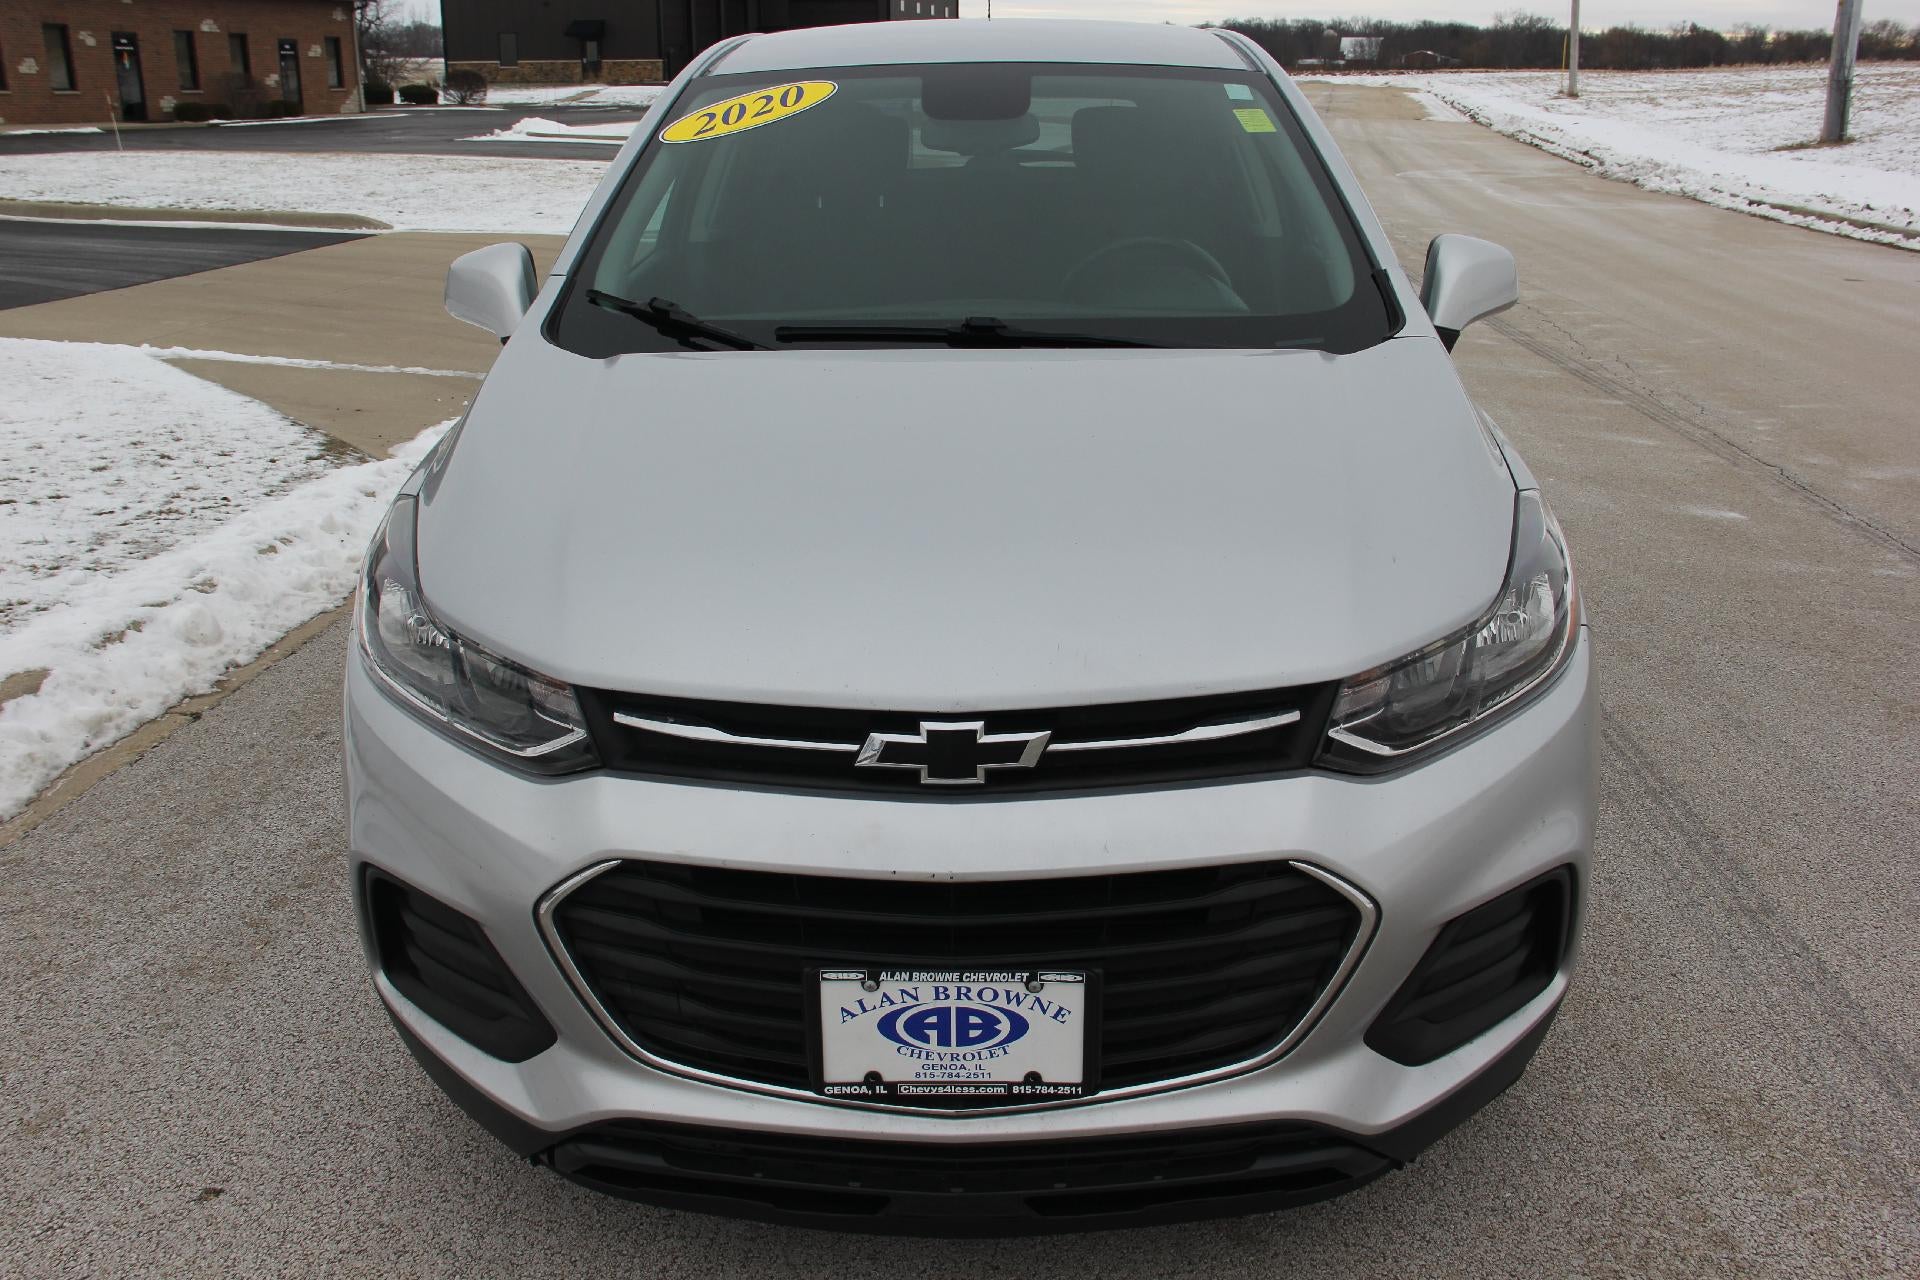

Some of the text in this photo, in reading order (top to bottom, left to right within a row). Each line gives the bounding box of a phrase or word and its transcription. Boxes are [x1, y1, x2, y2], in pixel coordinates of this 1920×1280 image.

[693, 86, 804, 136] 2020
[879, 971, 910, 982] ALAN
[912, 972, 960, 982] BROWNE
[962, 972, 1030, 983] CHEVROLET
[840, 985, 1072, 1025] ALAN BROWNE
[903, 1006, 1003, 1048] AB
[896, 1045, 1010, 1062] CHEVROLET
[921, 1063, 986, 1072] GENOA, IL
[915, 1071, 992, 1079] 815-784-2511
[824, 1085, 887, 1095] GENOA, IL
[900, 1085, 1005, 1094] Chevys4less.com
[1012, 1085, 1083, 1095] 815-784-2511
